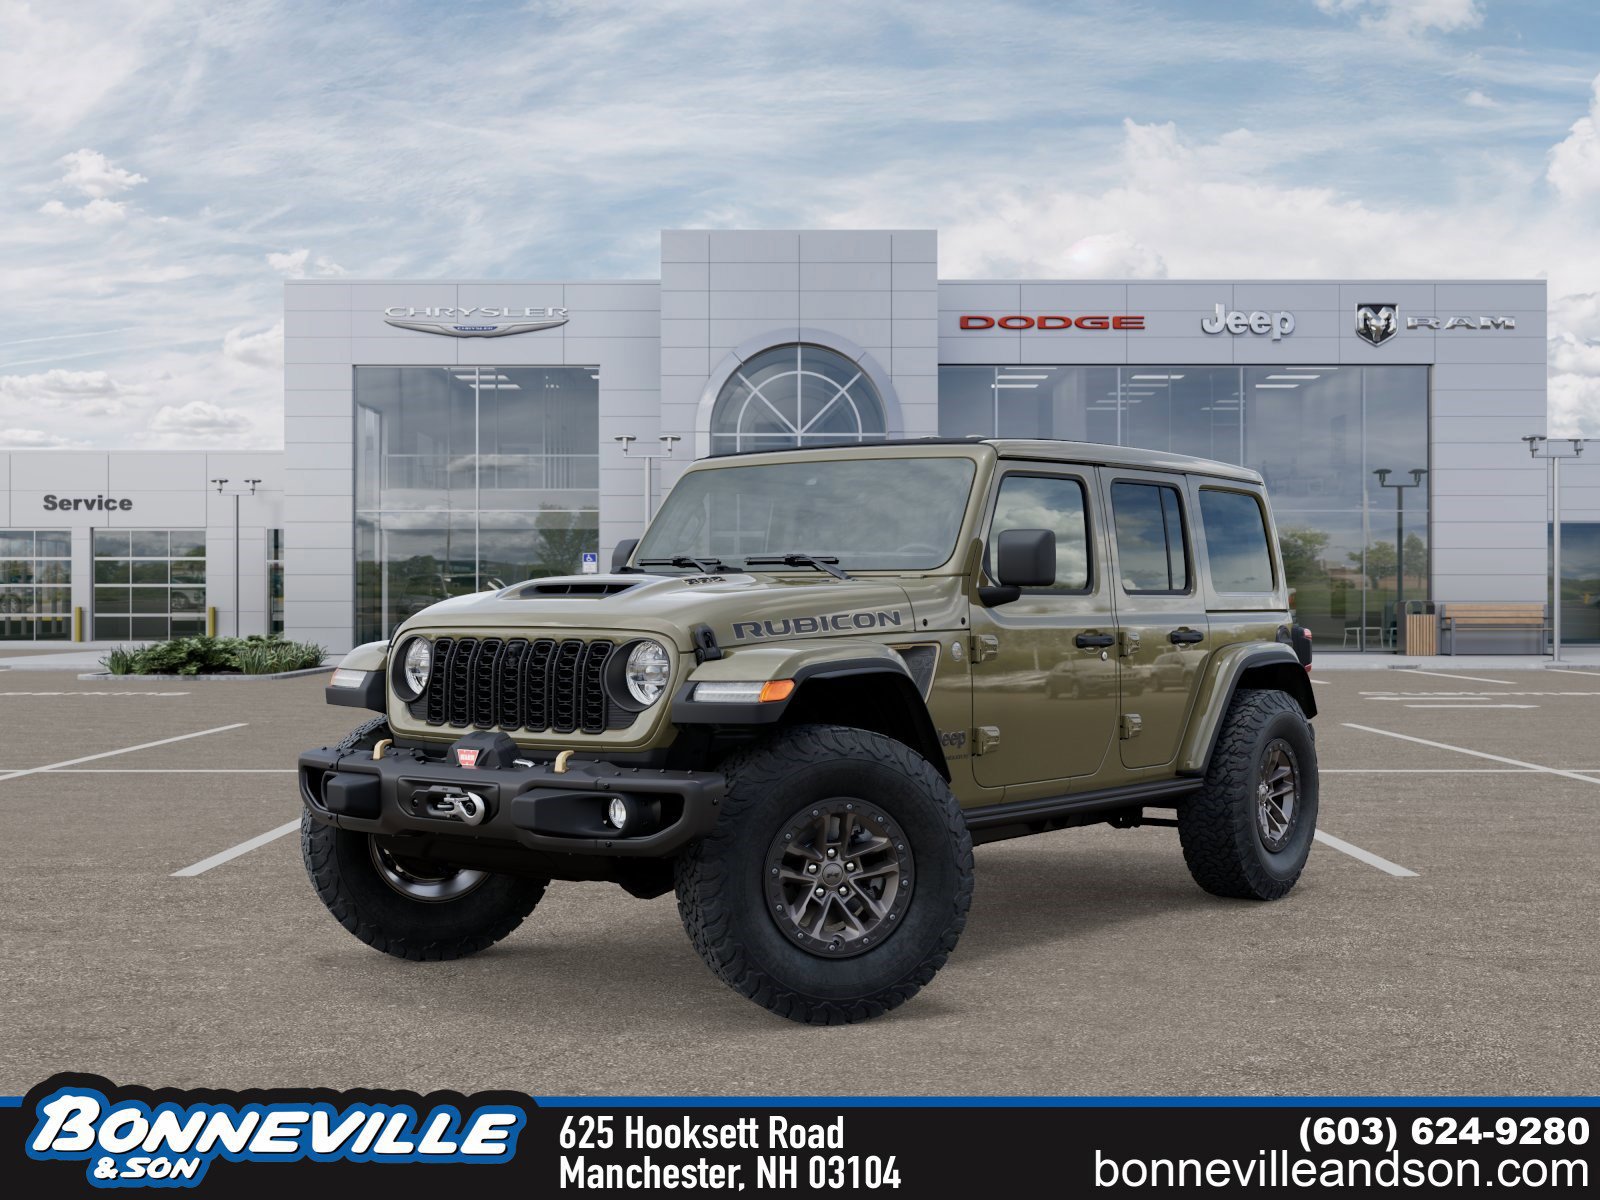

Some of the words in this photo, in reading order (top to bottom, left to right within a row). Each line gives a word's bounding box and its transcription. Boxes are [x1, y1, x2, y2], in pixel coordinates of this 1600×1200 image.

[385, 307, 569, 317] CHRYSLER
[959, 315, 1146, 330] DODGE
[1201, 303, 1296, 341] Jeep
[1406, 315, 1516, 331] RAM
[43, 494, 133, 511] Service
[732, 610, 903, 639] RUBICON
